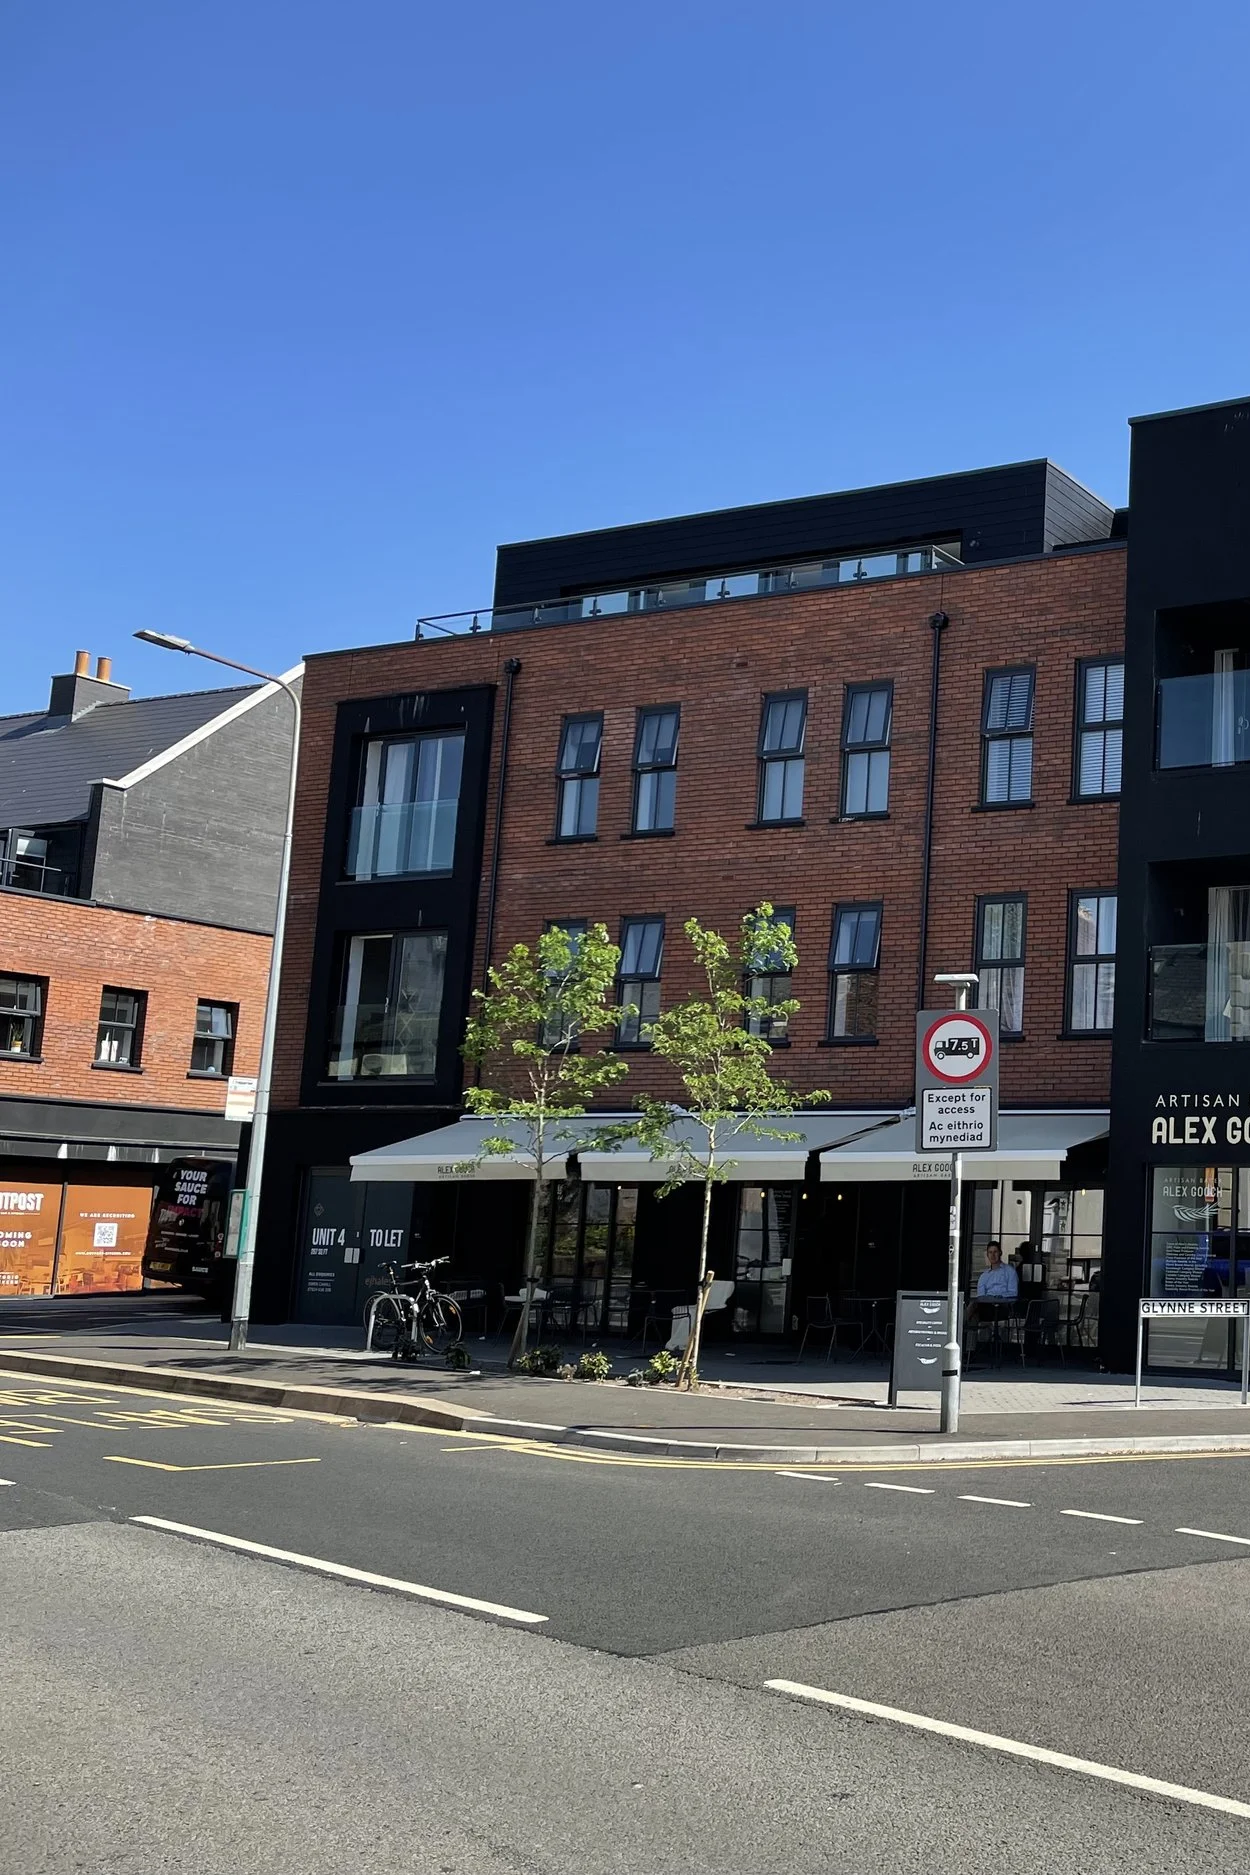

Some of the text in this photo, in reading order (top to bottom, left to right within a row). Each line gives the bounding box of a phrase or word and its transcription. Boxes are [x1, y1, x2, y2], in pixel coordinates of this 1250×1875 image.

[950, 1038, 979, 1051] 7.5 T
[927, 1092, 986, 1104] Except for
[1155, 1094, 1240, 1108] ARTISAN
[938, 1105, 975, 1114] access
[929, 1120, 984, 1131] Ac eithrio
[1151, 1116, 1217, 1145] ALEX
[929, 1132, 983, 1144] mynediad
[912, 1163, 953, 1173] ALEX GOO
[180, 1170, 208, 1182] YOUR
[174, 1182, 208, 1195] SAUCE
[1162, 1185, 1223, 1198] ALEX GOOCH
[176, 1194, 197, 1206] FOR
[0, 1231, 32, 1240] OMING
[312, 1227, 404, 1248] UNIT 4 TO LET
[0, 1240, 25, 1248] OON
[1141, 1302, 1248, 1314] GLYNNE STREET
